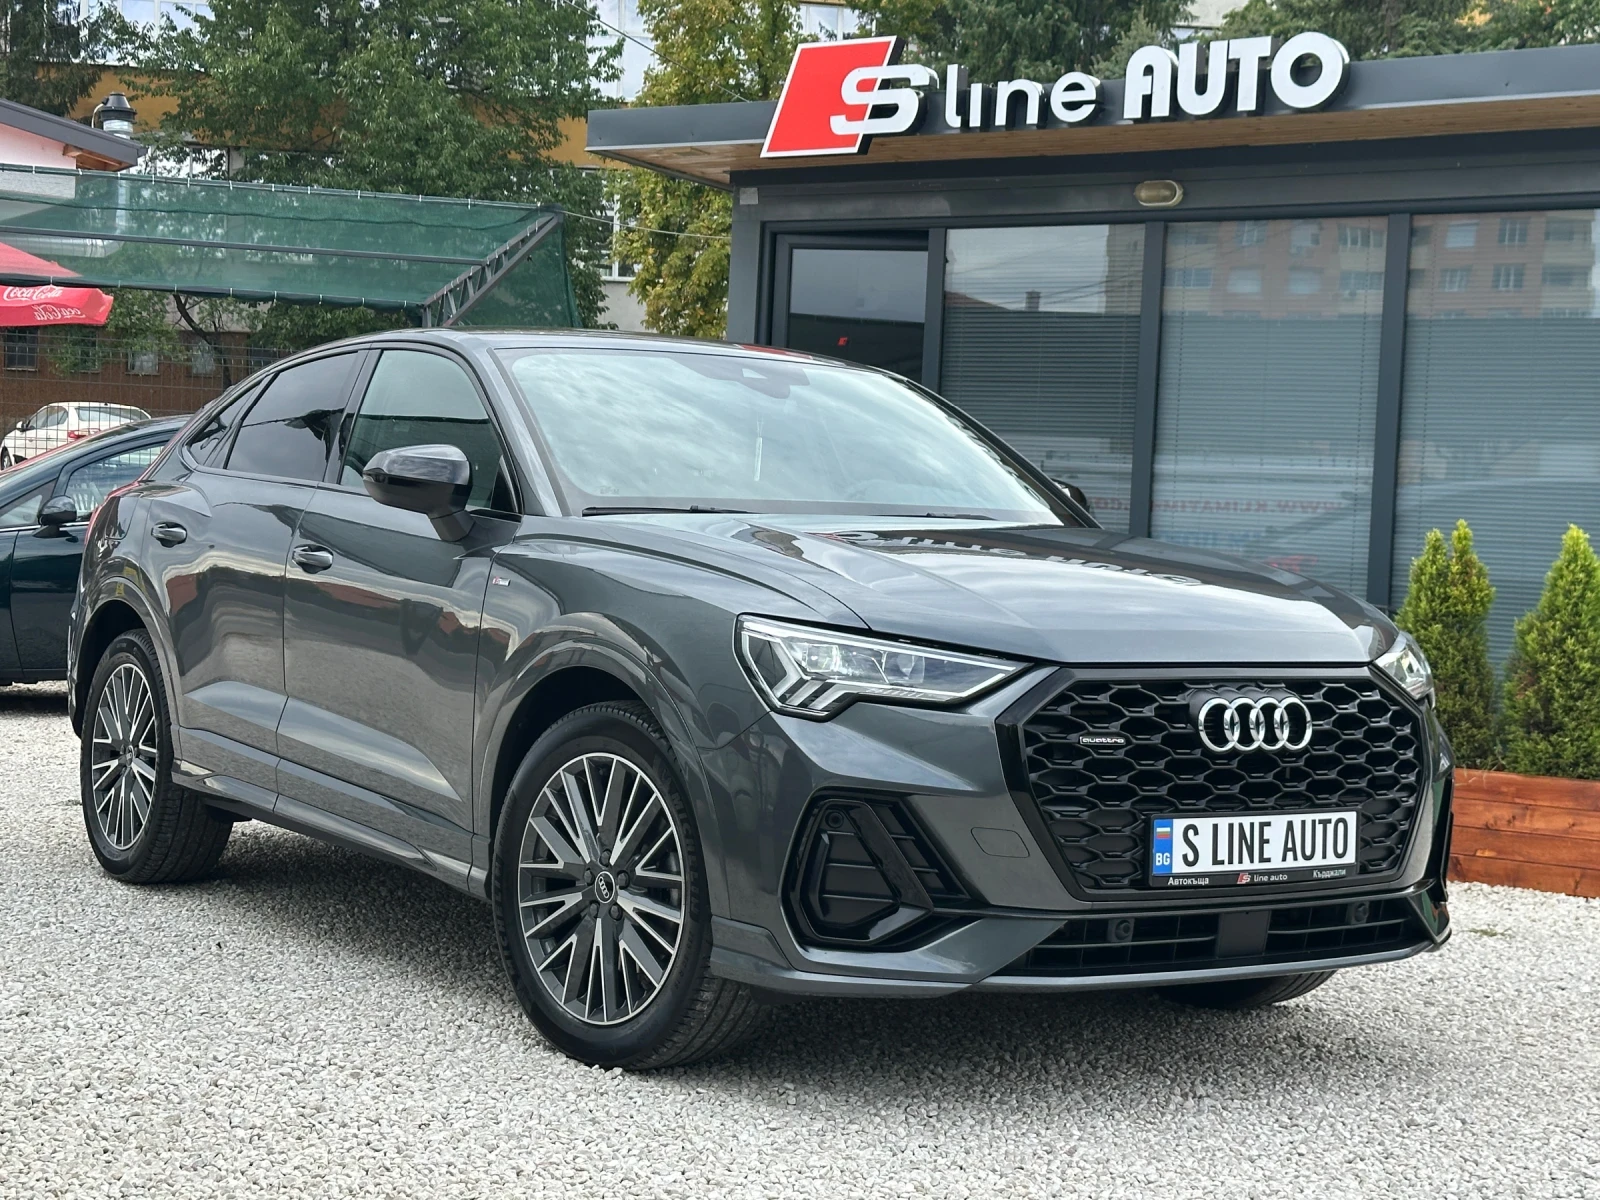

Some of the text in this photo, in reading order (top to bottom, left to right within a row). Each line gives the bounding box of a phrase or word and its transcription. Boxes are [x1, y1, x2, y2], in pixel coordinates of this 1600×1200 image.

[829, 64, 930, 136] S
[1122, 31, 1344, 119] AUTO
[1182, 817, 1349, 867] S LINE AUTO
[1155, 853, 1171, 866] BG
[1253, 874, 1268, 882] line
[1270, 873, 1288, 882] auto
[1312, 868, 1347, 879] Кърджали
[1168, 876, 1210, 886] Автокъща
